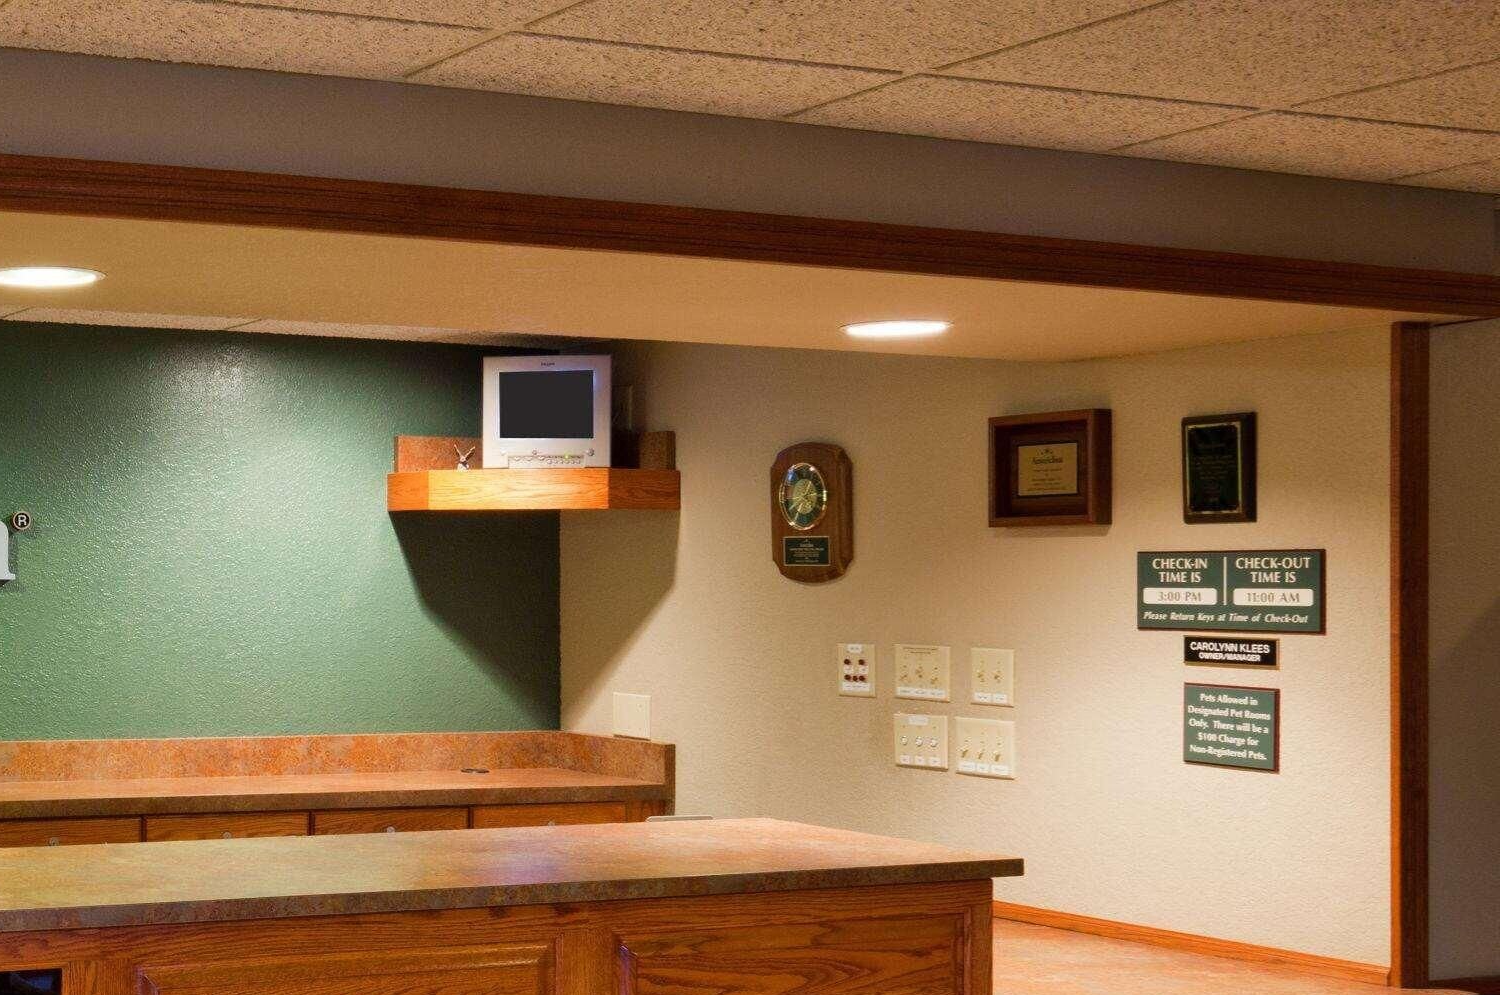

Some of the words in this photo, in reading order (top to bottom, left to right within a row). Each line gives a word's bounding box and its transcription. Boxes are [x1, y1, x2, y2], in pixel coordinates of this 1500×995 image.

[1152, 558, 1208, 569] CHECK-IN
[1235, 557, 1311, 569] CHECK-OUT
[1158, 571, 1187, 583] TIME
[1190, 571, 1202, 583] IS
[1250, 571, 1281, 583] TIME
[1285, 571, 1297, 583] IS
[1158, 591, 1181, 602] 3:00
[1185, 591, 1202, 602] PM
[1246, 592, 1275, 603] 11:00
[1280, 592, 1300, 603] AM
[1143, 611, 1168, 620] Please
[1170, 612, 1196, 621] Return
[1197, 612, 1215, 623] Keys
[1217, 613, 1227, 621] at
[1229, 612, 1249, 622] Time
[1251, 613, 1262, 622] of
[1264, 613, 1309, 623] Check-Out
[1190, 641, 1238, 652] CAROLYNN
[1240, 643, 1270, 654] KLEES
[1198, 652, 1261, 662] OWNER/MANAGER
[1200, 693, 1216, 703] Pets
[1217, 694, 1249, 705] Allowed
[1249, 696, 1258, 706] in
[1187, 705, 1229, 717] Designated
[1230, 708, 1243, 718] Pet
[1244, 710, 1271, 721] Rooms
[1188, 718, 1209, 730] Only.
[1213, 720, 1235, 731] There
[1236, 722, 1251, 732] will
[1251, 723, 1262, 733] be
[1263, 726, 1269, 734] a
[1218, 734, 1246, 747] Charge
[1247, 736, 1259, 746] for
[1189, 744, 1247, 758] Non-Registered
[1248, 750, 1268, 760] Pets.
